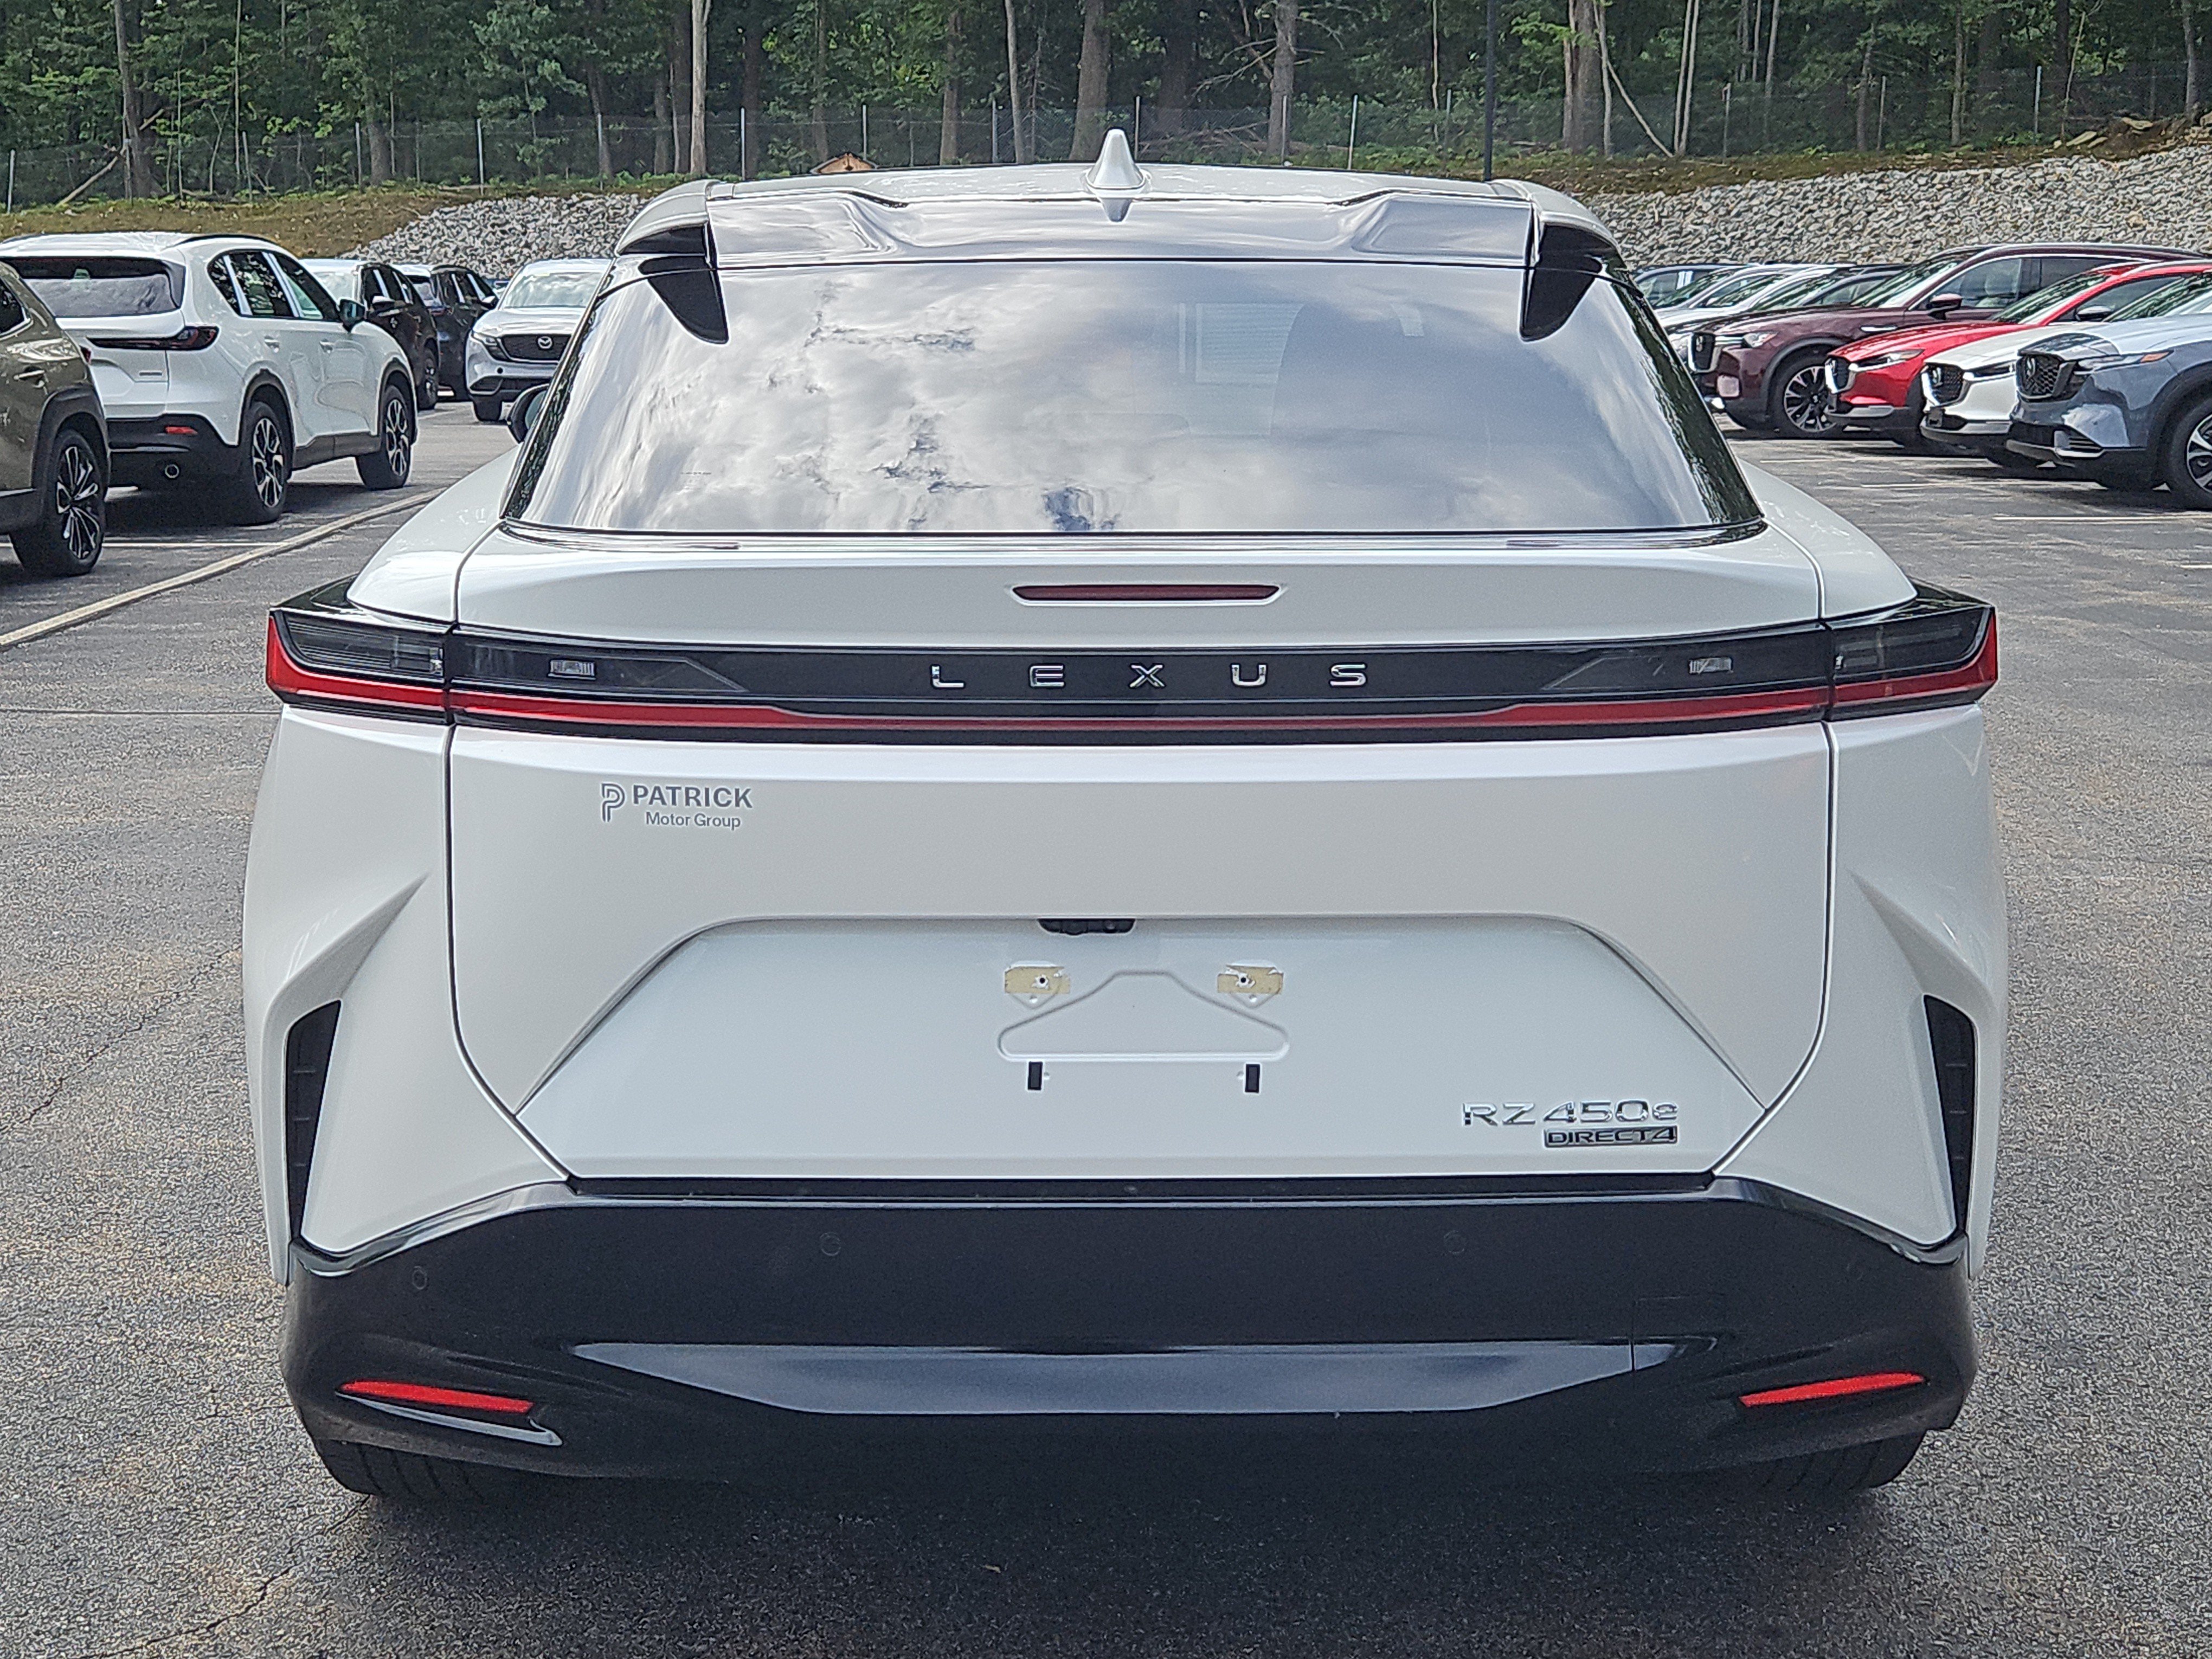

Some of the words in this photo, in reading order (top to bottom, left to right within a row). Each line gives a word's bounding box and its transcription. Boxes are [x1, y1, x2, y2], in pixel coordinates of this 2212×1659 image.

[930, 664, 1367, 689] LEXUS
[633, 784, 753, 808] PATRICK
[646, 811, 690, 826] Motor
[693, 813, 741, 831] Group
[1463, 1103, 1536, 1126] RZ
[1542, 1099, 1678, 1123] 450e
[1548, 1127, 1676, 1144] DIRECT4
